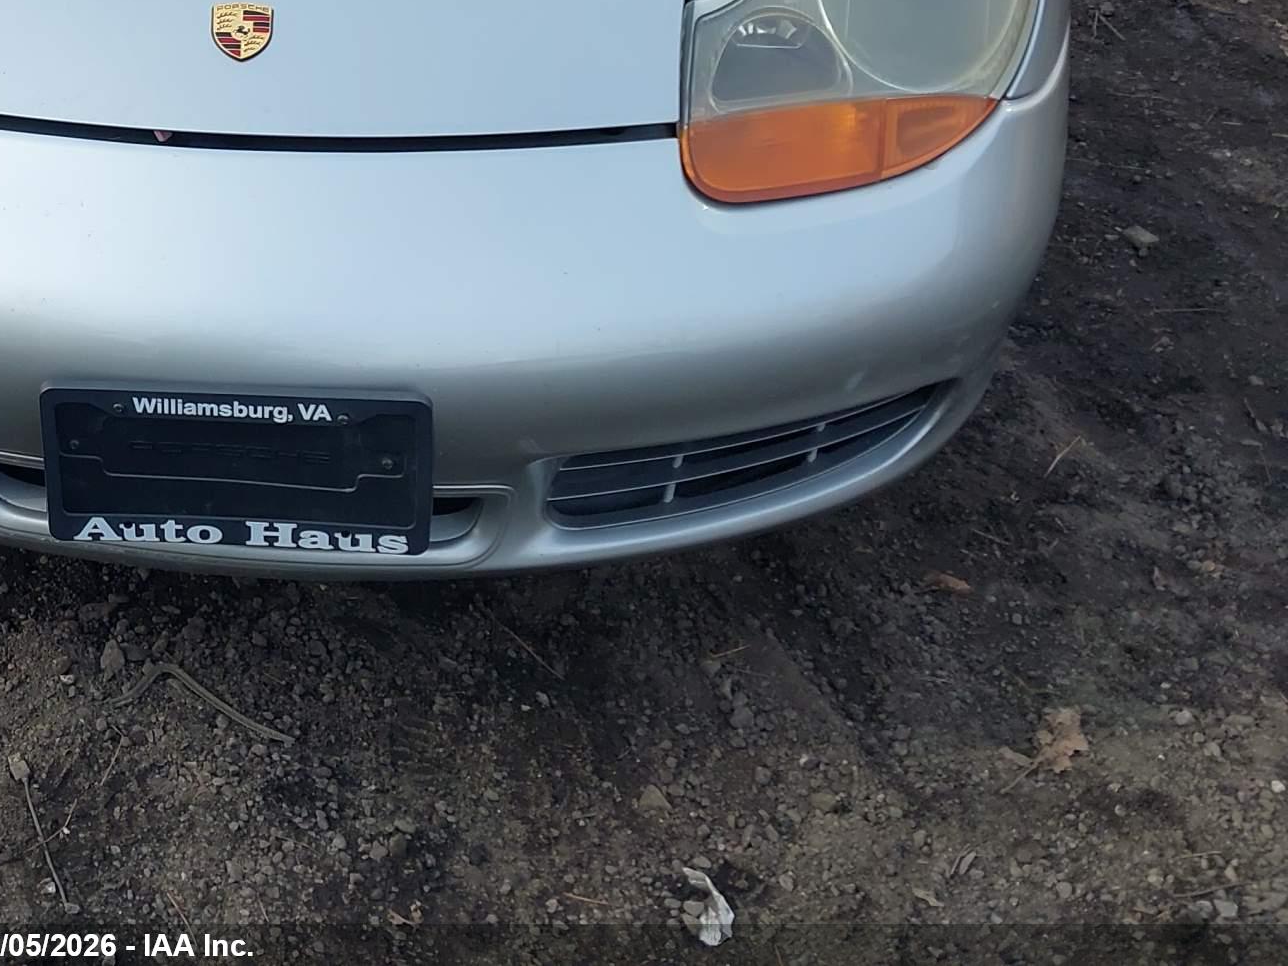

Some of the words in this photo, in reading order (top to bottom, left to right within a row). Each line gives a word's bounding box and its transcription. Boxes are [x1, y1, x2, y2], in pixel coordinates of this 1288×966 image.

[216, 3, 270, 13] PORSCHE
[132, 397, 293, 423] Williamsburg,
[297, 403, 332, 422] VA
[73, 516, 223, 544] Auto
[245, 520, 410, 555] Haus
